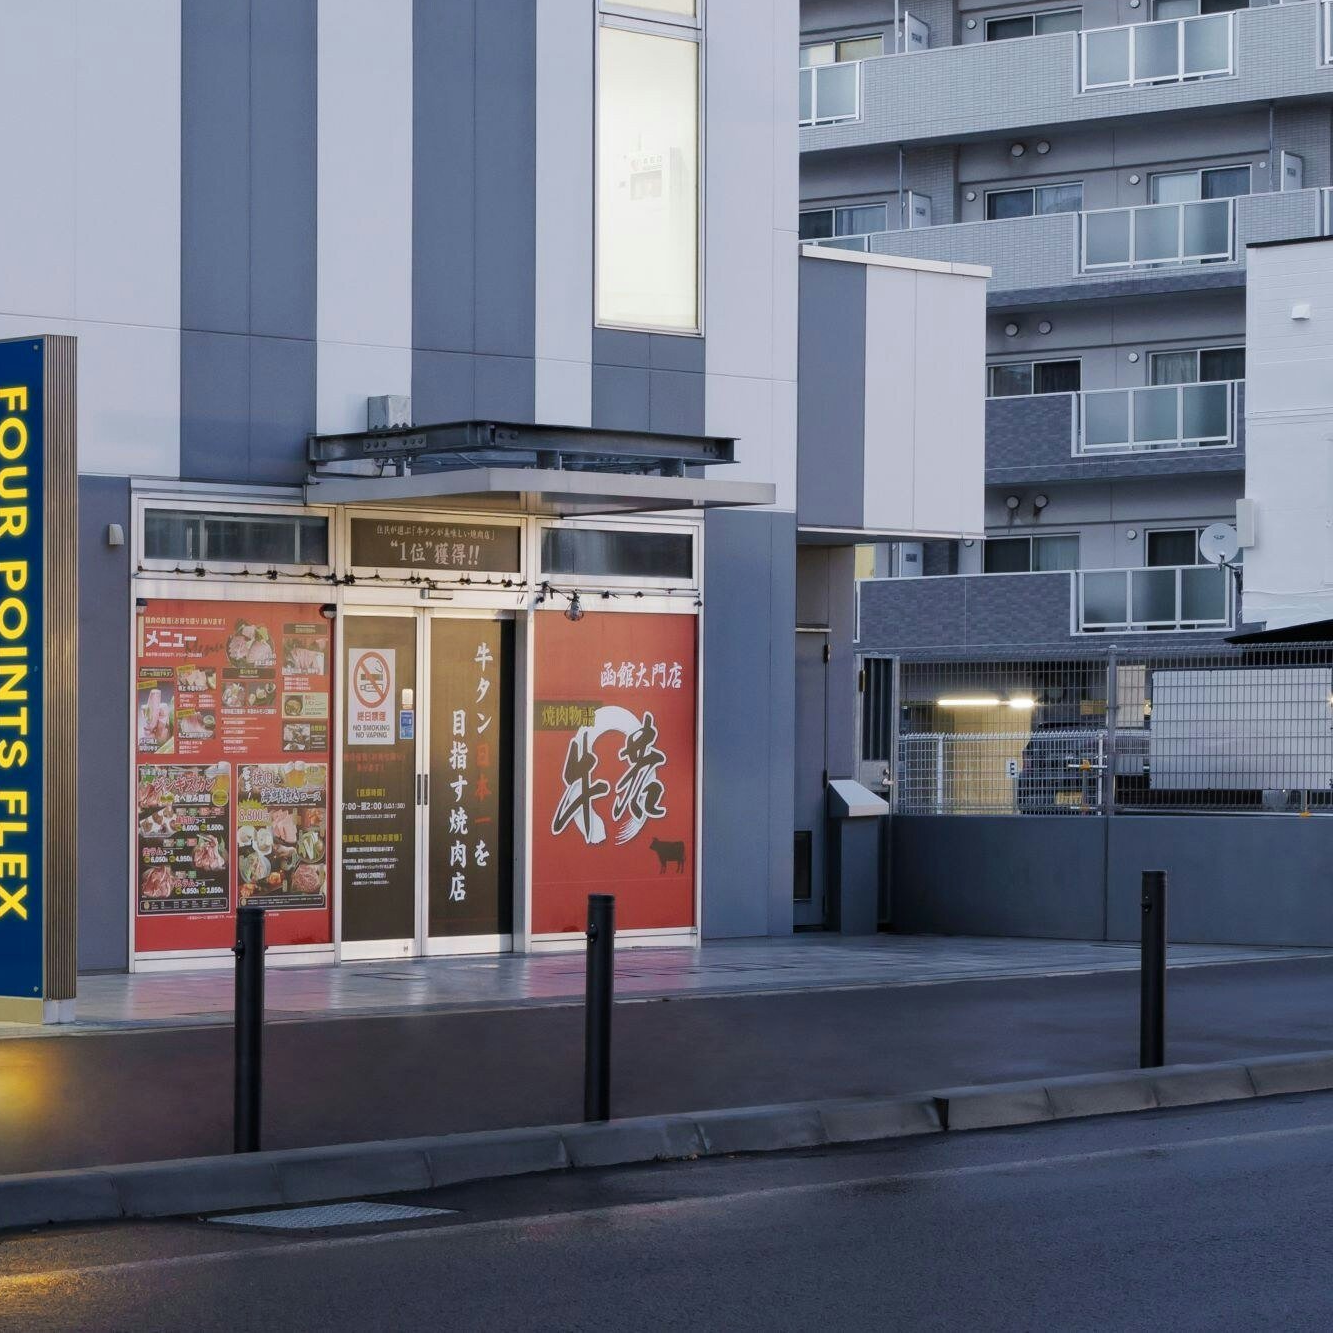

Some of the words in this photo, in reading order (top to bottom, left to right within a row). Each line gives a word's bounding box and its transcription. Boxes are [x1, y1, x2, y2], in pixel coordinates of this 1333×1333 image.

[145, 630, 197, 648] メニュー
[600, 661, 684, 689] 函館大門店
[541, 705, 596, 728] 焼肉物語
[474, 642, 493, 867] 牛タン日本一を
[153, 775, 216, 793] ジンギスカン
[448, 709, 469, 902] 目指す焼肉店
